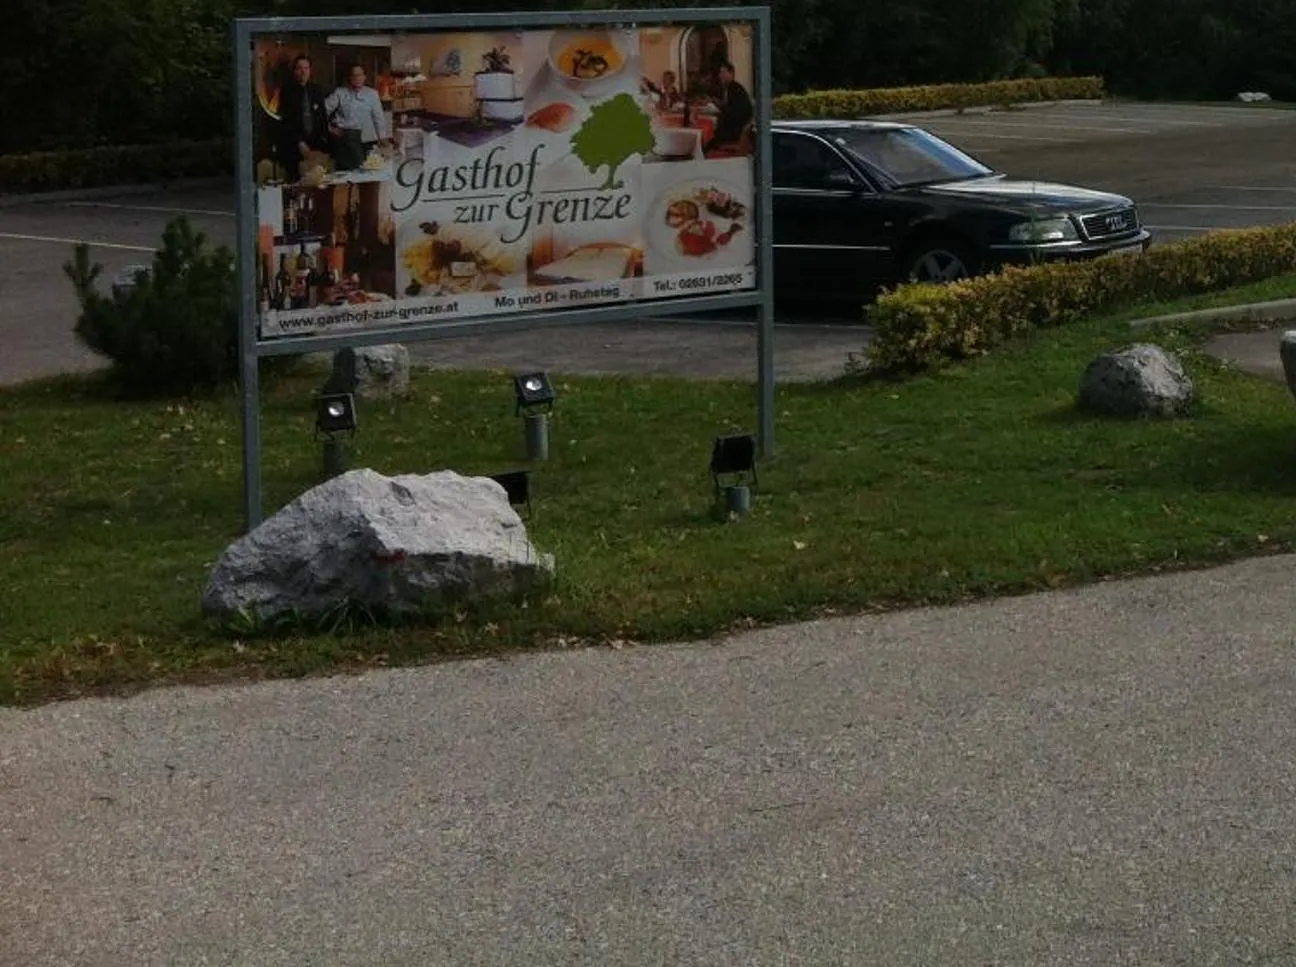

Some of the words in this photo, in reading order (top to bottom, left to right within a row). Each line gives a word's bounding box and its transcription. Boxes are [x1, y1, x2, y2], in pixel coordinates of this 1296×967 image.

[390, 144, 545, 212] Gasthof
[455, 203, 500, 225] zur
[500, 191, 633, 244] Grenze
[279, 301, 460, 330] www.gasthof-zur-grenze.at
[494, 295, 515, 309] Mo
[518, 294, 541, 307] und
